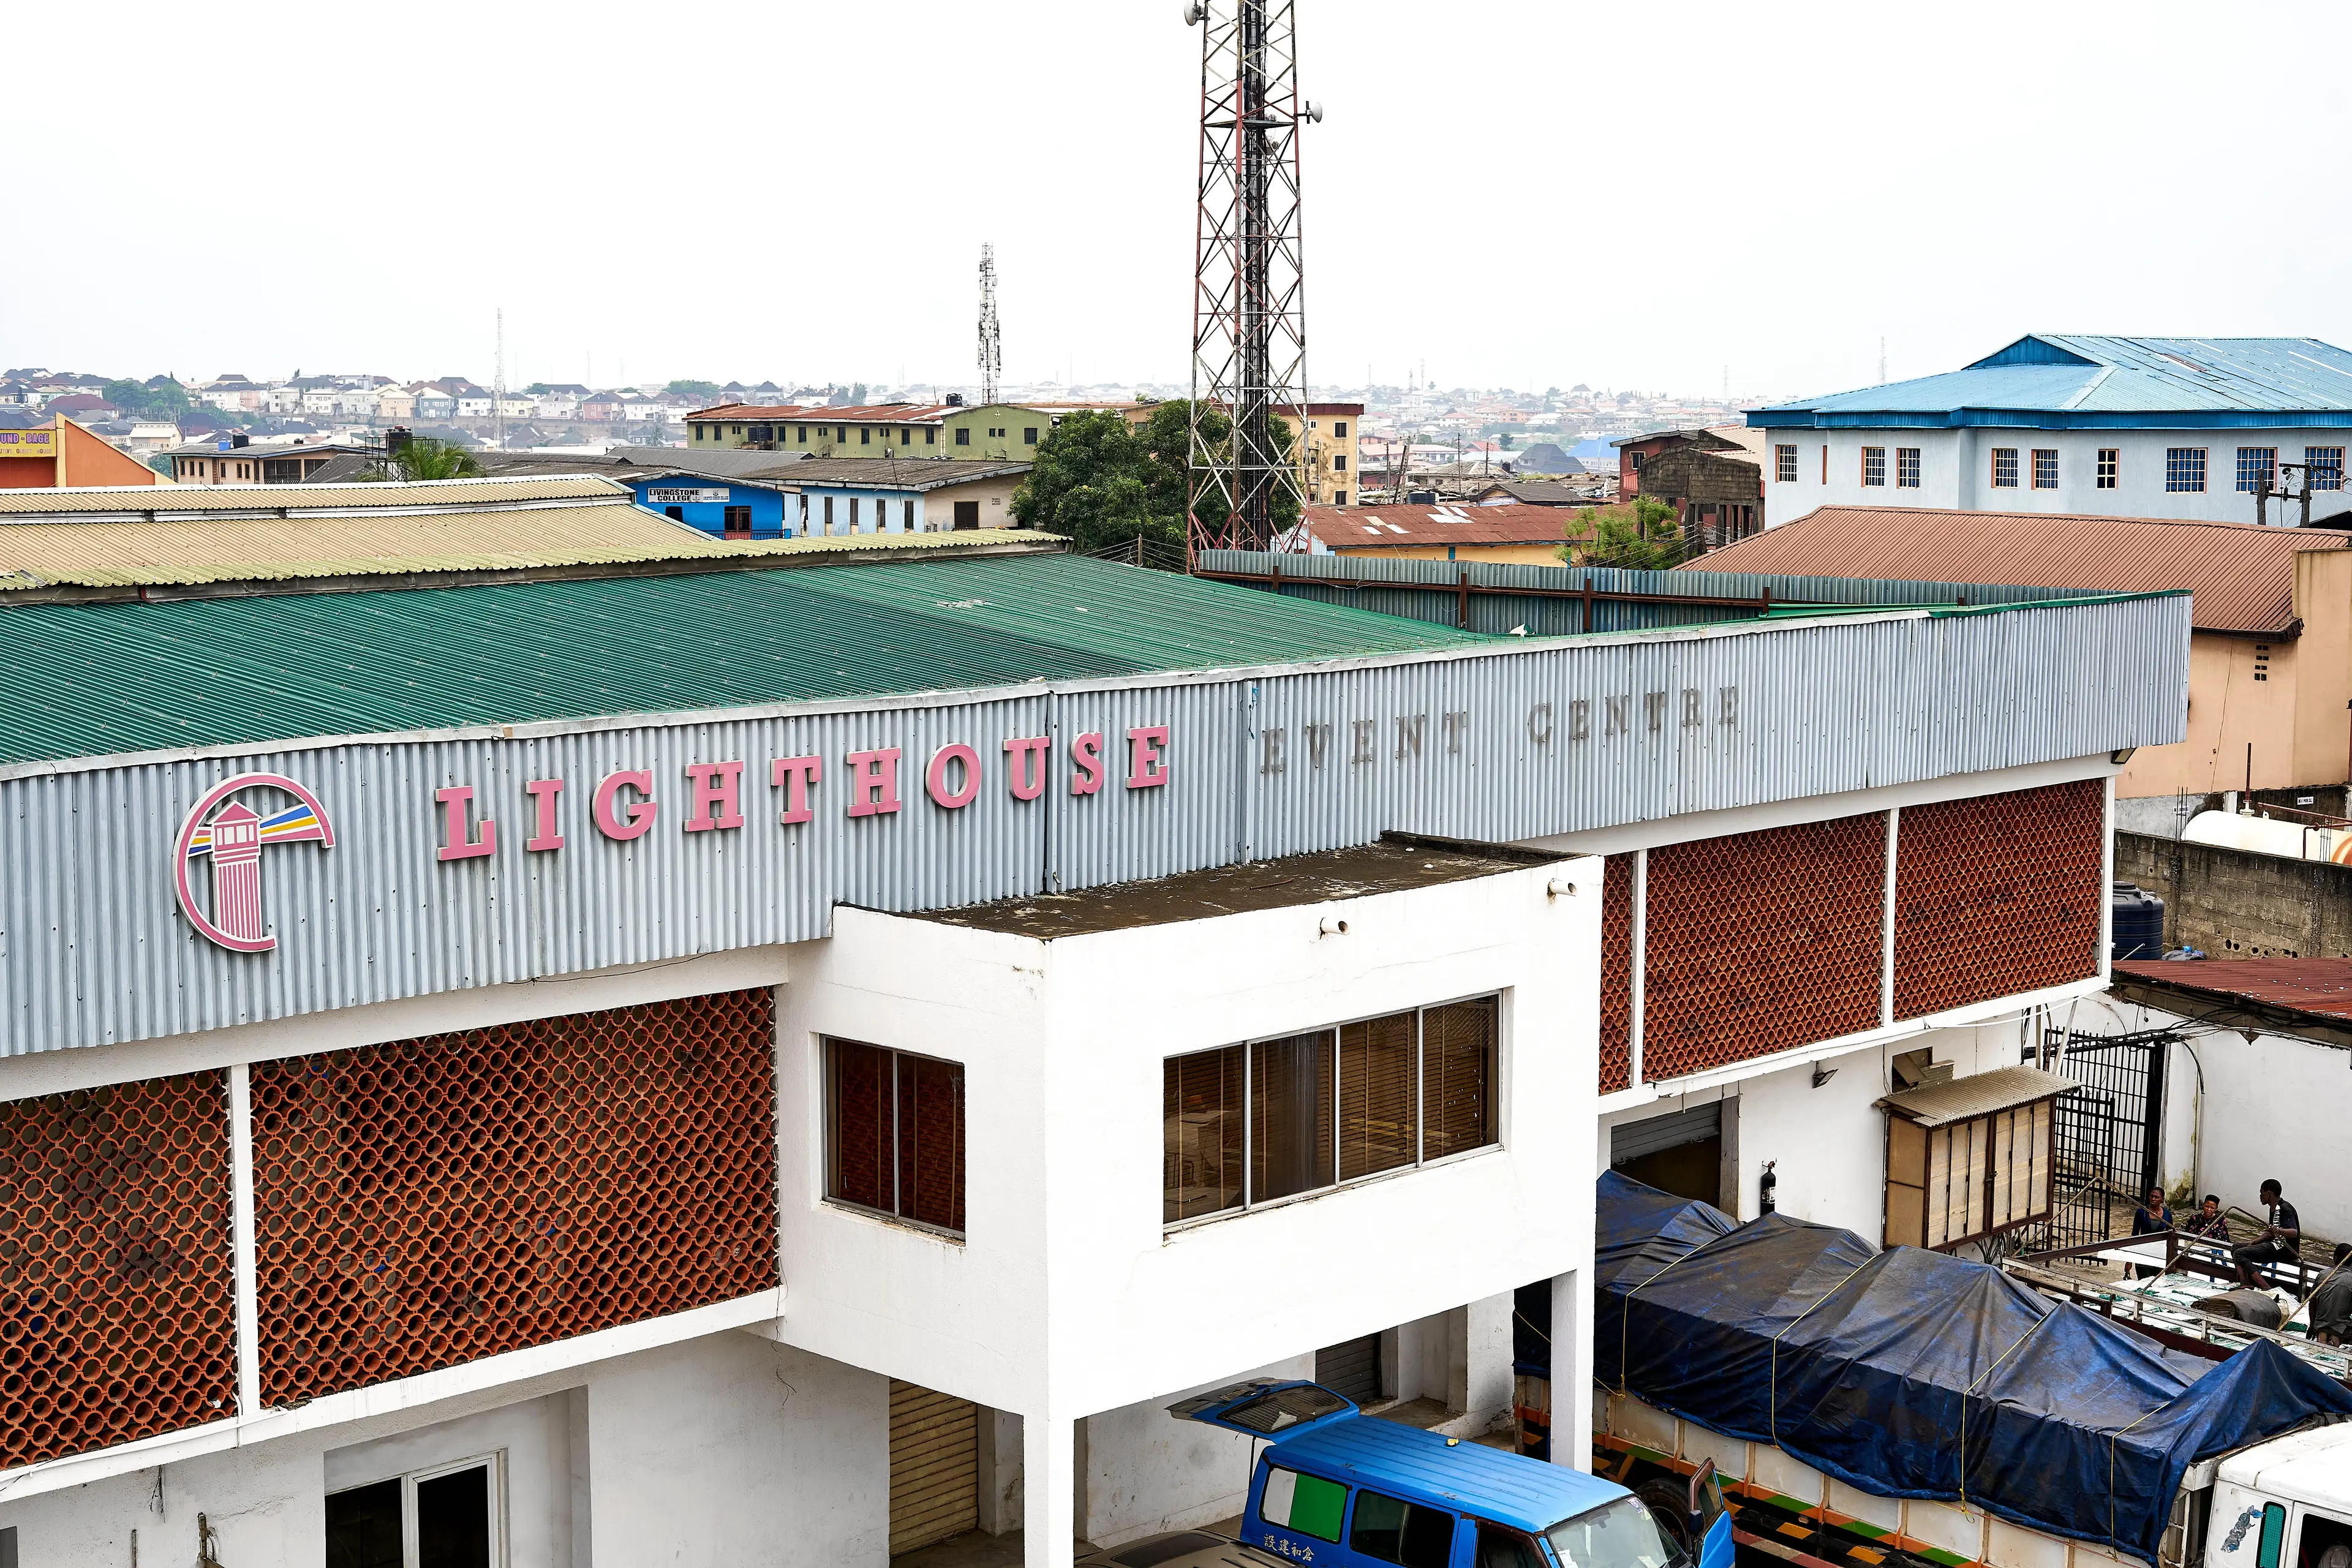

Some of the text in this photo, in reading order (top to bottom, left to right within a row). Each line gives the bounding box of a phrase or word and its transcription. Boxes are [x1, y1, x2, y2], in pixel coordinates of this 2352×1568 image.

[435, 686, 1740, 861] LIGHTHOUSE EVENT CENTRE
